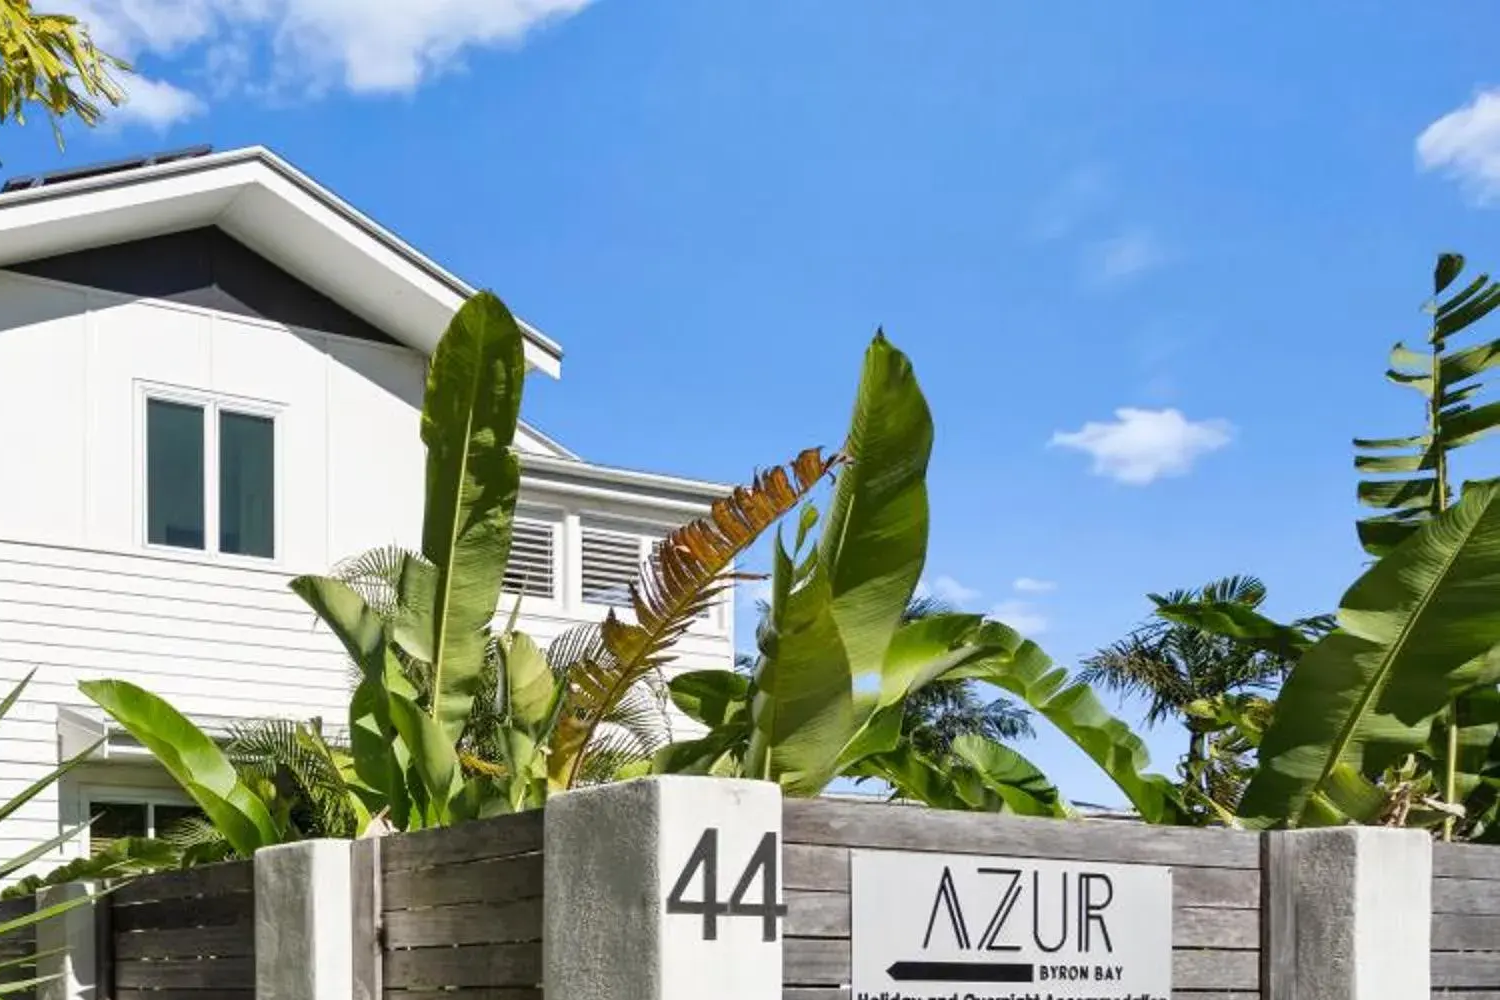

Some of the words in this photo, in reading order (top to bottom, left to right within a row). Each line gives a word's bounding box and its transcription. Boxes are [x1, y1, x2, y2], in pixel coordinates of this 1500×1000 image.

[665, 827, 788, 943] 44
[922, 865, 1114, 953] AZUR
[1039, 965, 1089, 981] BYRON
[1094, 965, 1124, 981] BAY
